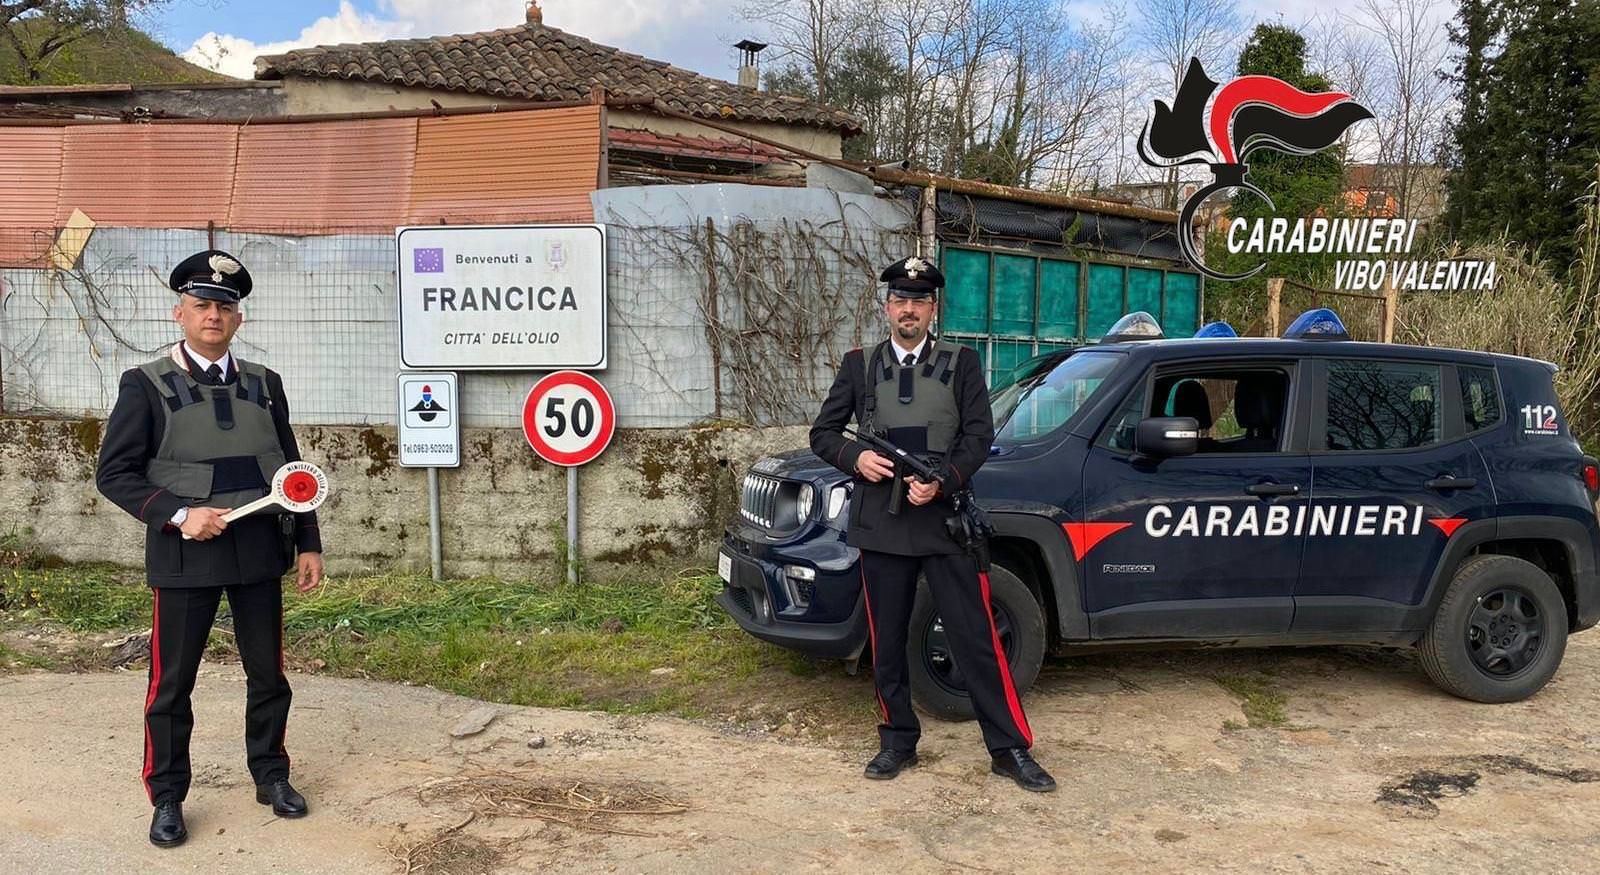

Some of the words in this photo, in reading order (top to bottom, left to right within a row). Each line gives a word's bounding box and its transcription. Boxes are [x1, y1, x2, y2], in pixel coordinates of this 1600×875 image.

[455, 254, 519, 264] Benvenuti
[525, 256, 532, 264] a
[423, 286, 578, 312] FRANCICA
[492, 332, 560, 345] DELL'OLIO
[543, 397, 594, 439] 50
[1521, 404, 1558, 429] 112
[1144, 504, 1424, 538] CARABINIERI
